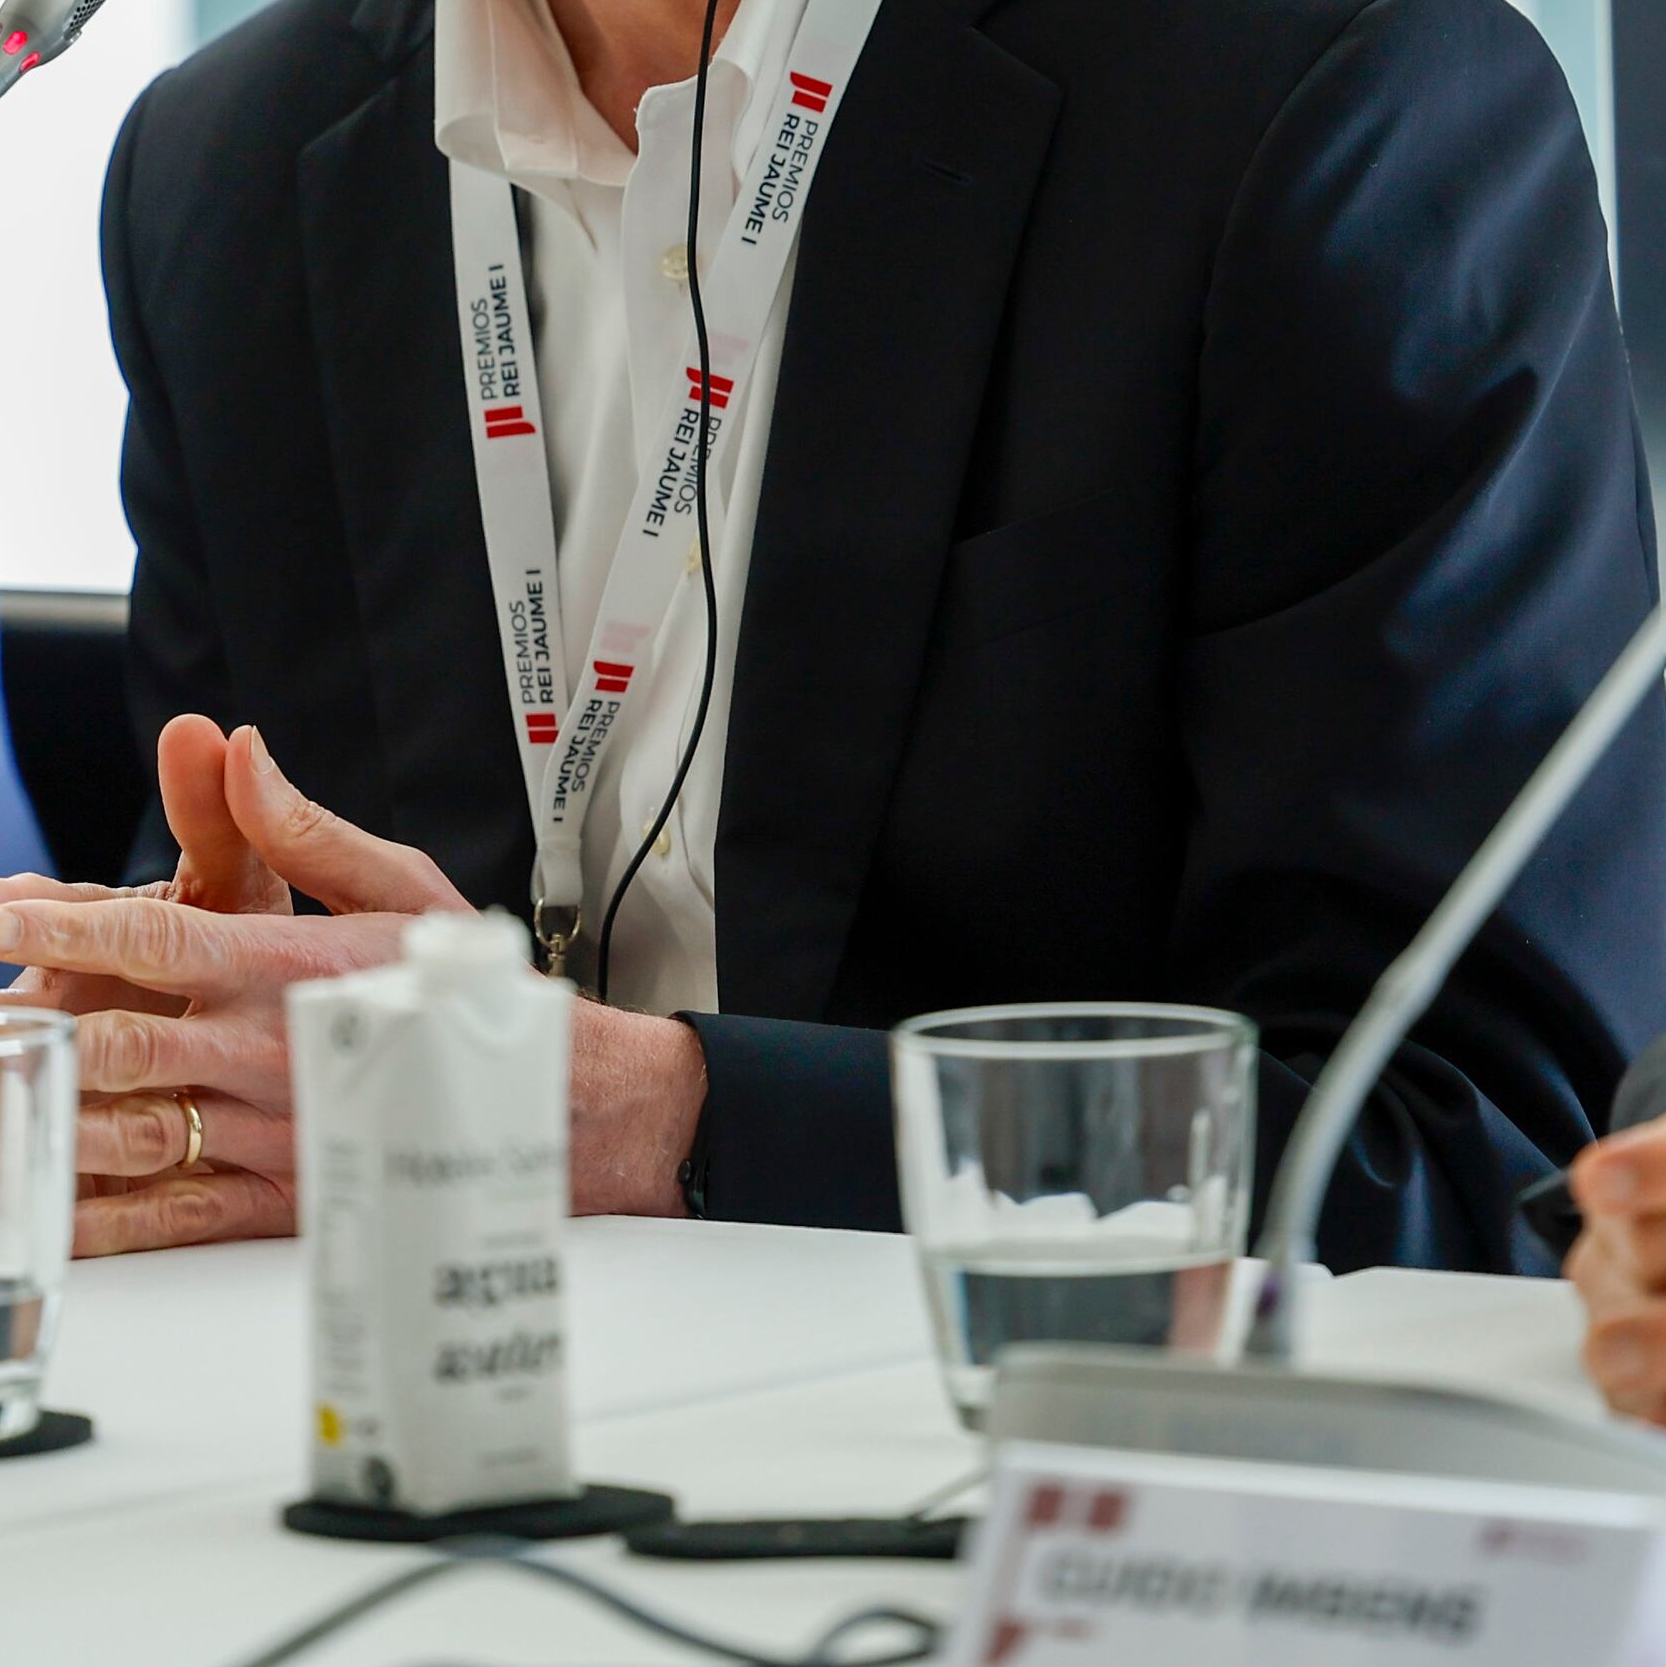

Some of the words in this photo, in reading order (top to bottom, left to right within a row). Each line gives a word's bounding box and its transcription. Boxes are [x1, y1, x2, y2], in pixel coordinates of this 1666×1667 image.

[776, 113, 800, 151] REI
[745, 154, 787, 235] JAUME
[772, 119, 819, 223] PREMIOS
[488, 264, 504, 272] I
[741, 236, 757, 245] I
[471, 298, 498, 401] PREMIOS
[489, 276, 515, 356] JAUME
[501, 361, 521, 398] REI
[674, 408, 700, 445] REI
[646, 447, 687, 526] JAUME
[642, 529, 659, 537] I
[509, 600, 536, 704] PREMIOS
[526, 581, 550, 661] JAUME
[537, 667, 554, 703] REI
[577, 699, 603, 731] REI
[553, 736, 586, 810] JAUME
[571, 701, 621, 792] PREMIOS
